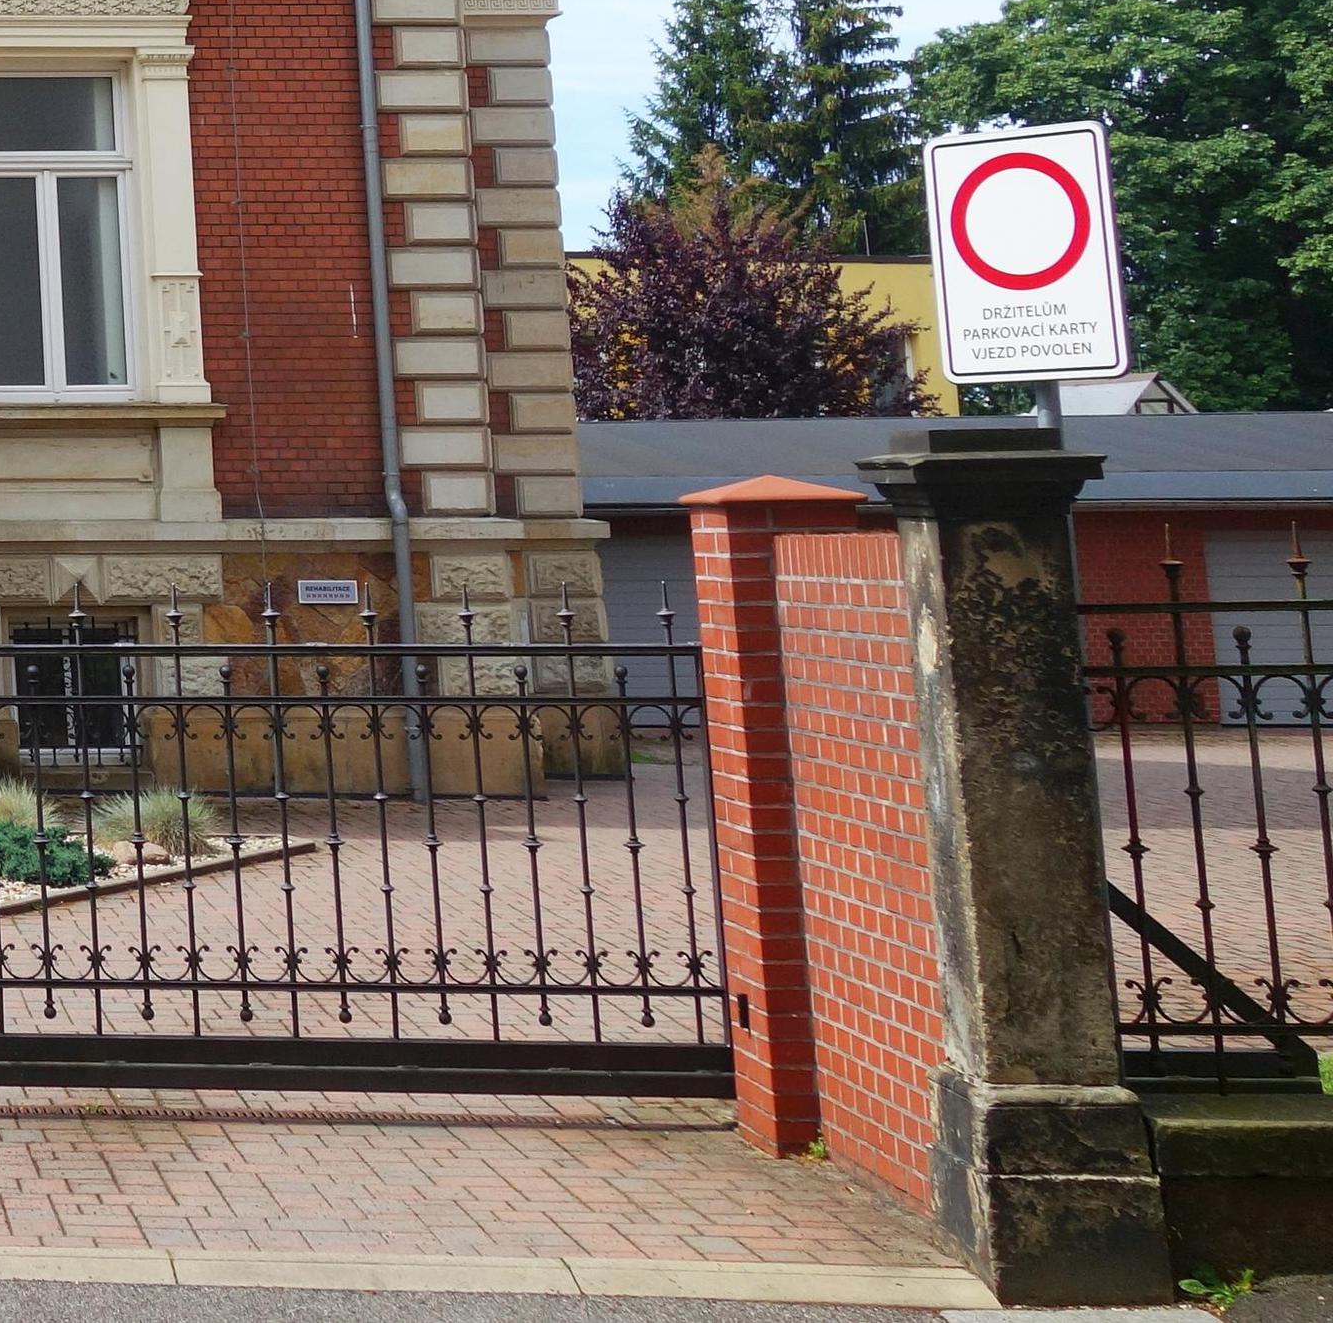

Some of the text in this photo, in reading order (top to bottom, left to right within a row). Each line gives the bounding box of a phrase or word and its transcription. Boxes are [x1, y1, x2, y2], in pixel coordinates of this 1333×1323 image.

[982, 301, 1067, 320] DRŽITELŮM
[963, 321, 1098, 341] PARKOVACÍ KARTY
[971, 342, 1093, 360] VJEZD POVOLEN
